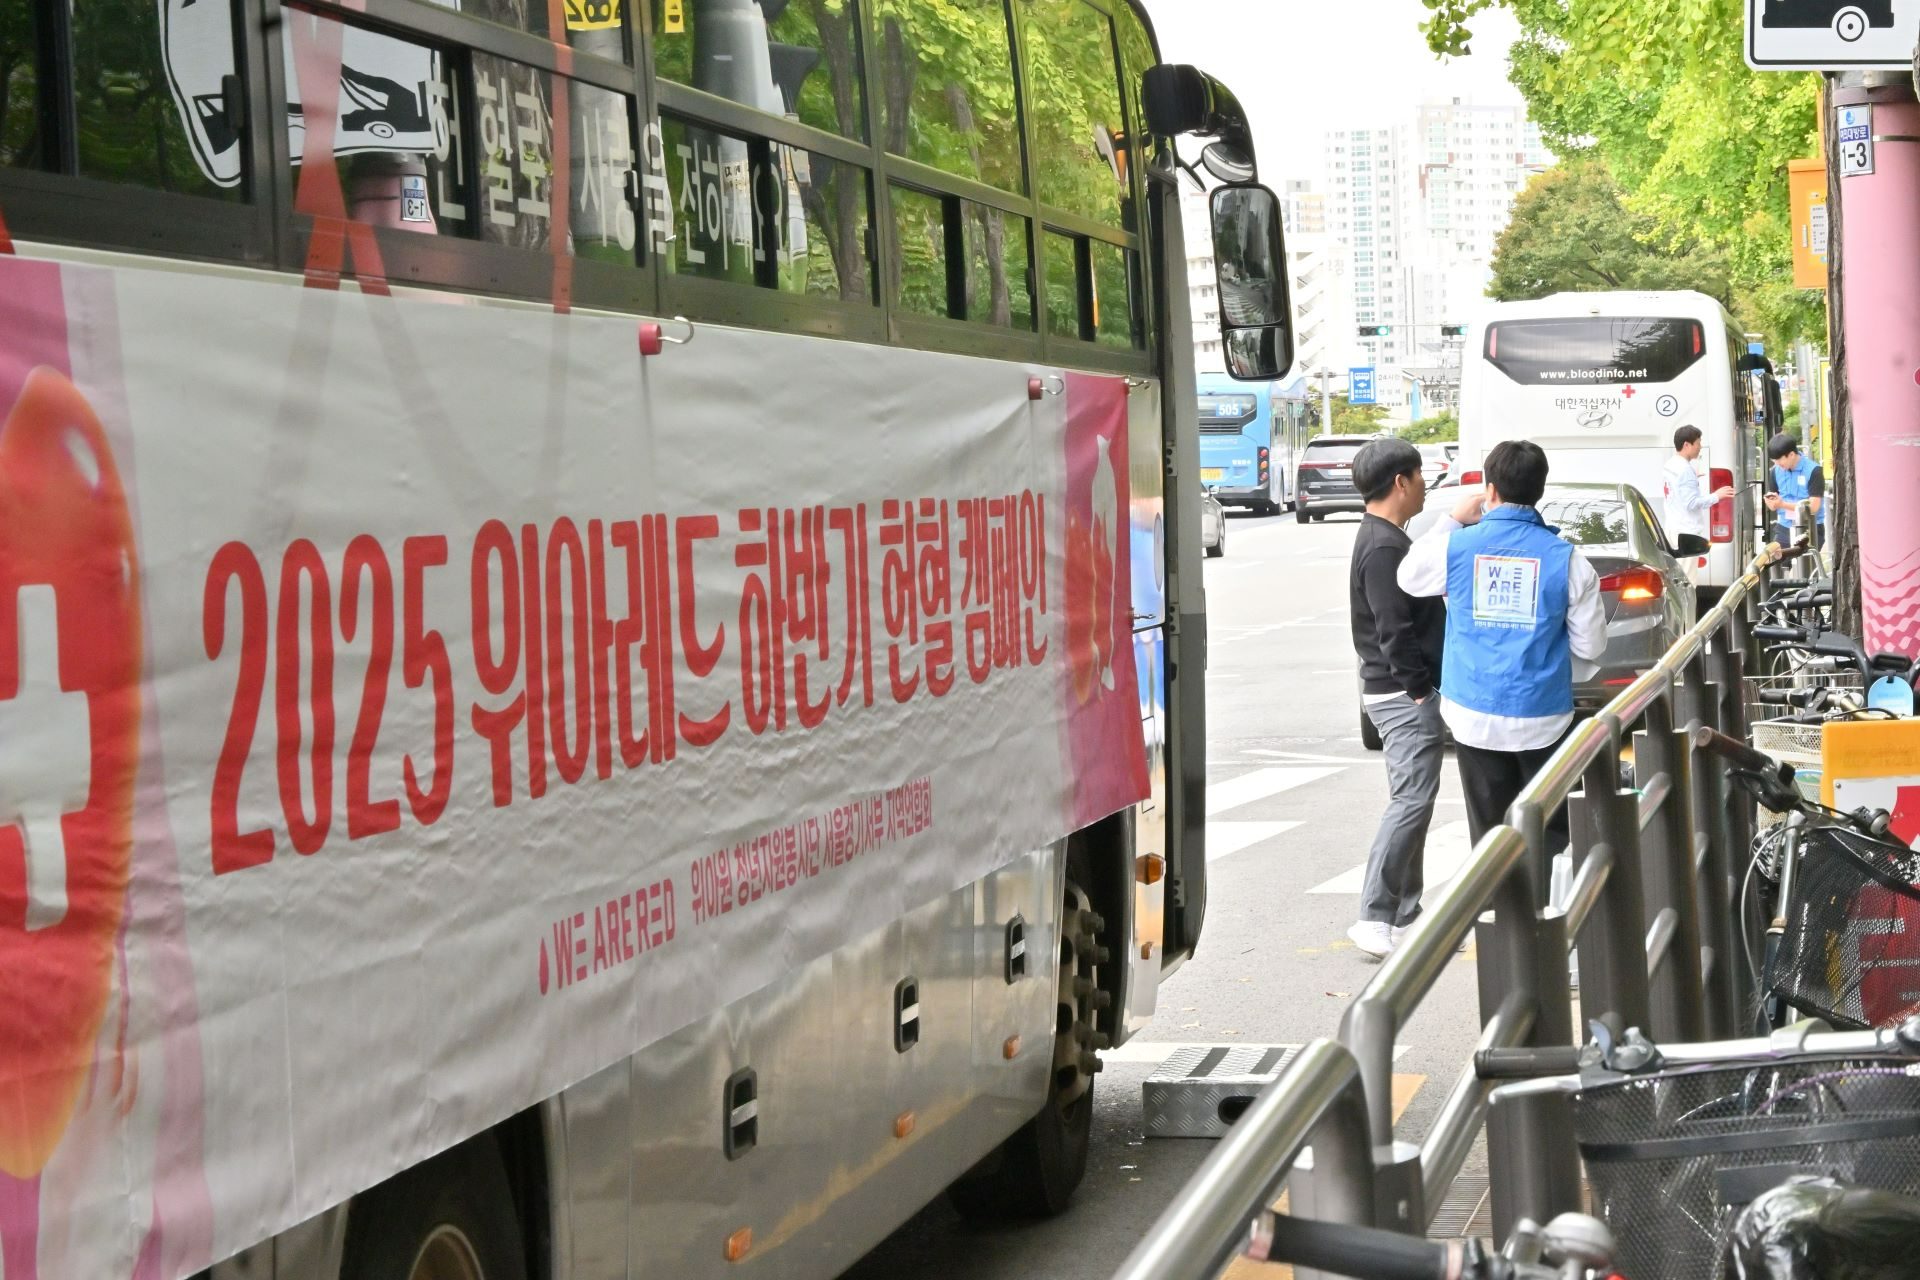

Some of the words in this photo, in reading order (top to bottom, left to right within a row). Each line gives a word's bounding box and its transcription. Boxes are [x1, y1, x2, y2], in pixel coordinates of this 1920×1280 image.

[424, 52, 550, 228] 헌혈로
[580, 107, 667, 255] 사랑을
[1842, 142, 1867, 170] 1-3
[1540, 367, 1647, 380] www.bloodinfo.net
[1218, 403, 1239, 416] 505
[1555, 397, 1622, 411] 대한적십자사
[1488, 566, 1523, 579] WE
[1488, 580, 1522, 593] ARE
[1488, 594, 1521, 608] ONE
[203, 534, 454, 876] 2025
[471, 513, 730, 808] 위아레드
[735, 503, 873, 735] 하반기
[879, 497, 956, 704] 헌혈
[957, 488, 1048, 684] 캠페인
[553, 912, 587, 989] WE
[594, 893, 634, 974] ARE
[638, 878, 676, 953] RED
[691, 847, 733, 926] 위아원
